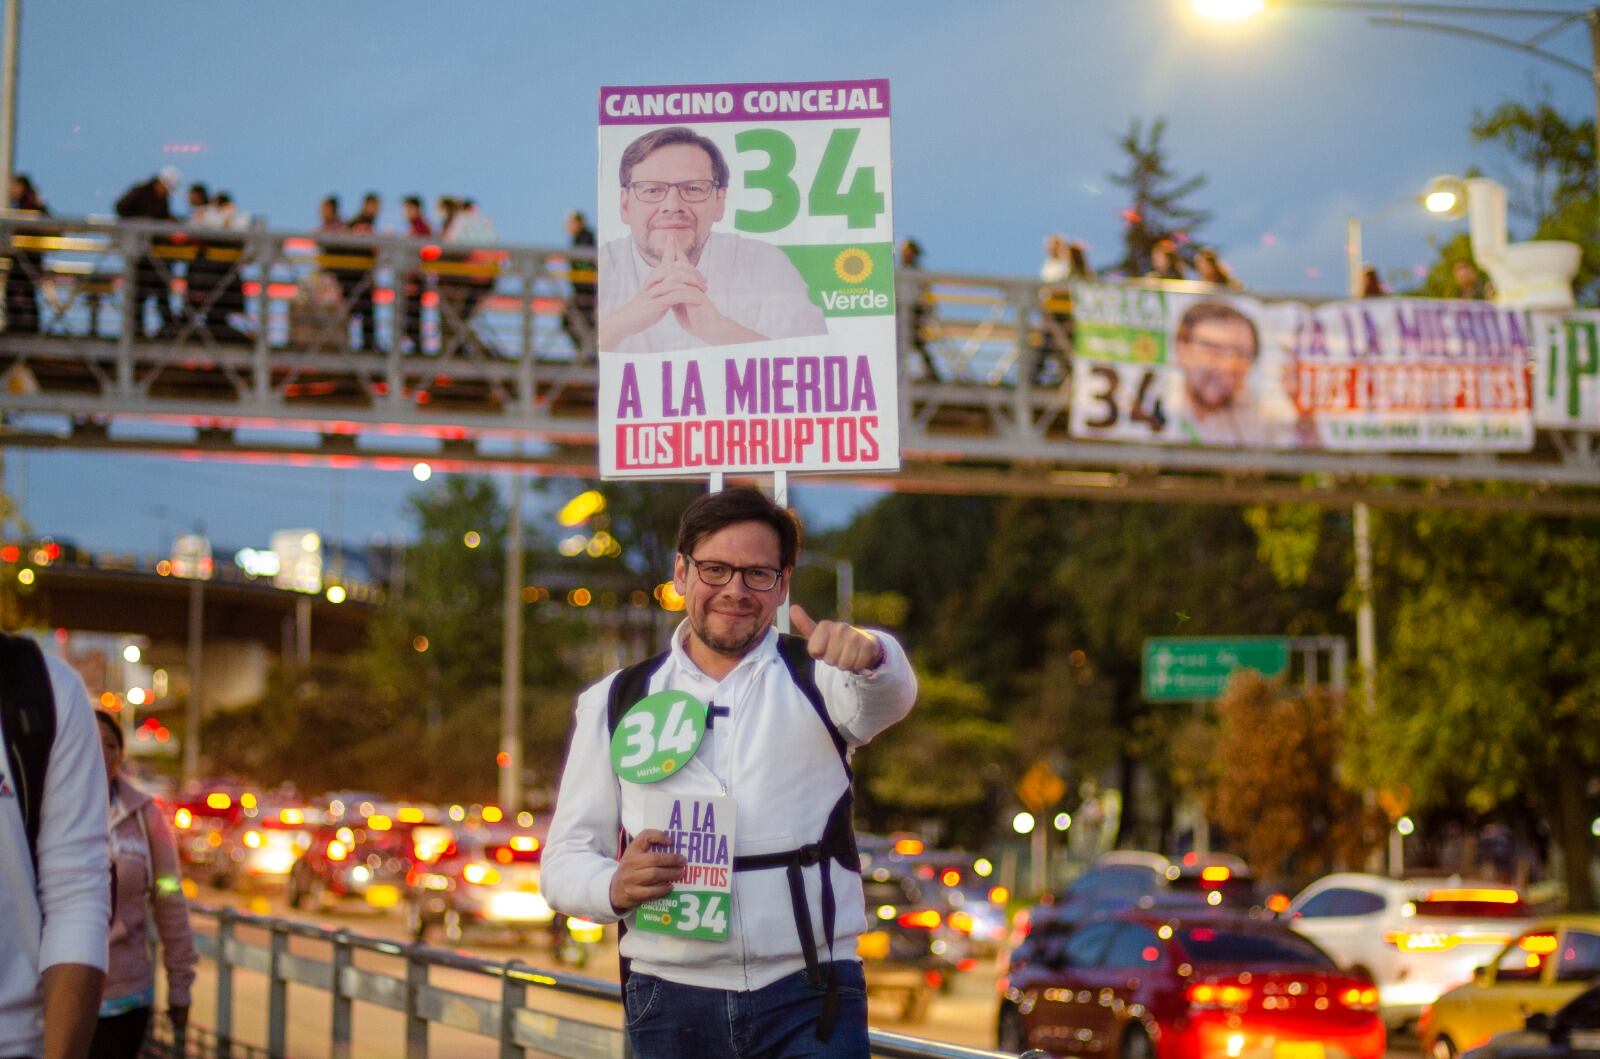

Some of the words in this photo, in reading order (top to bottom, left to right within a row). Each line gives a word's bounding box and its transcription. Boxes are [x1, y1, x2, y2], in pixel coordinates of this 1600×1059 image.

[605, 91, 734, 117] CANCINO
[743, 87, 883, 113] CONCEJAL
[734, 127, 885, 233] 34
[821, 289, 889, 310] Verde
[616, 362, 643, 418] A
[661, 360, 707, 417] LA
[725, 355, 877, 415] MIERDA
[1085, 366, 1167, 433] 34
[625, 425, 674, 465] LOS
[684, 416, 880, 467] CORRUPTOS
[620, 700, 697, 768] 34
[636, 766, 660, 777] Verde
[669, 799, 682, 830] A
[692, 801, 715, 832] LA
[677, 893, 726, 933] 34
